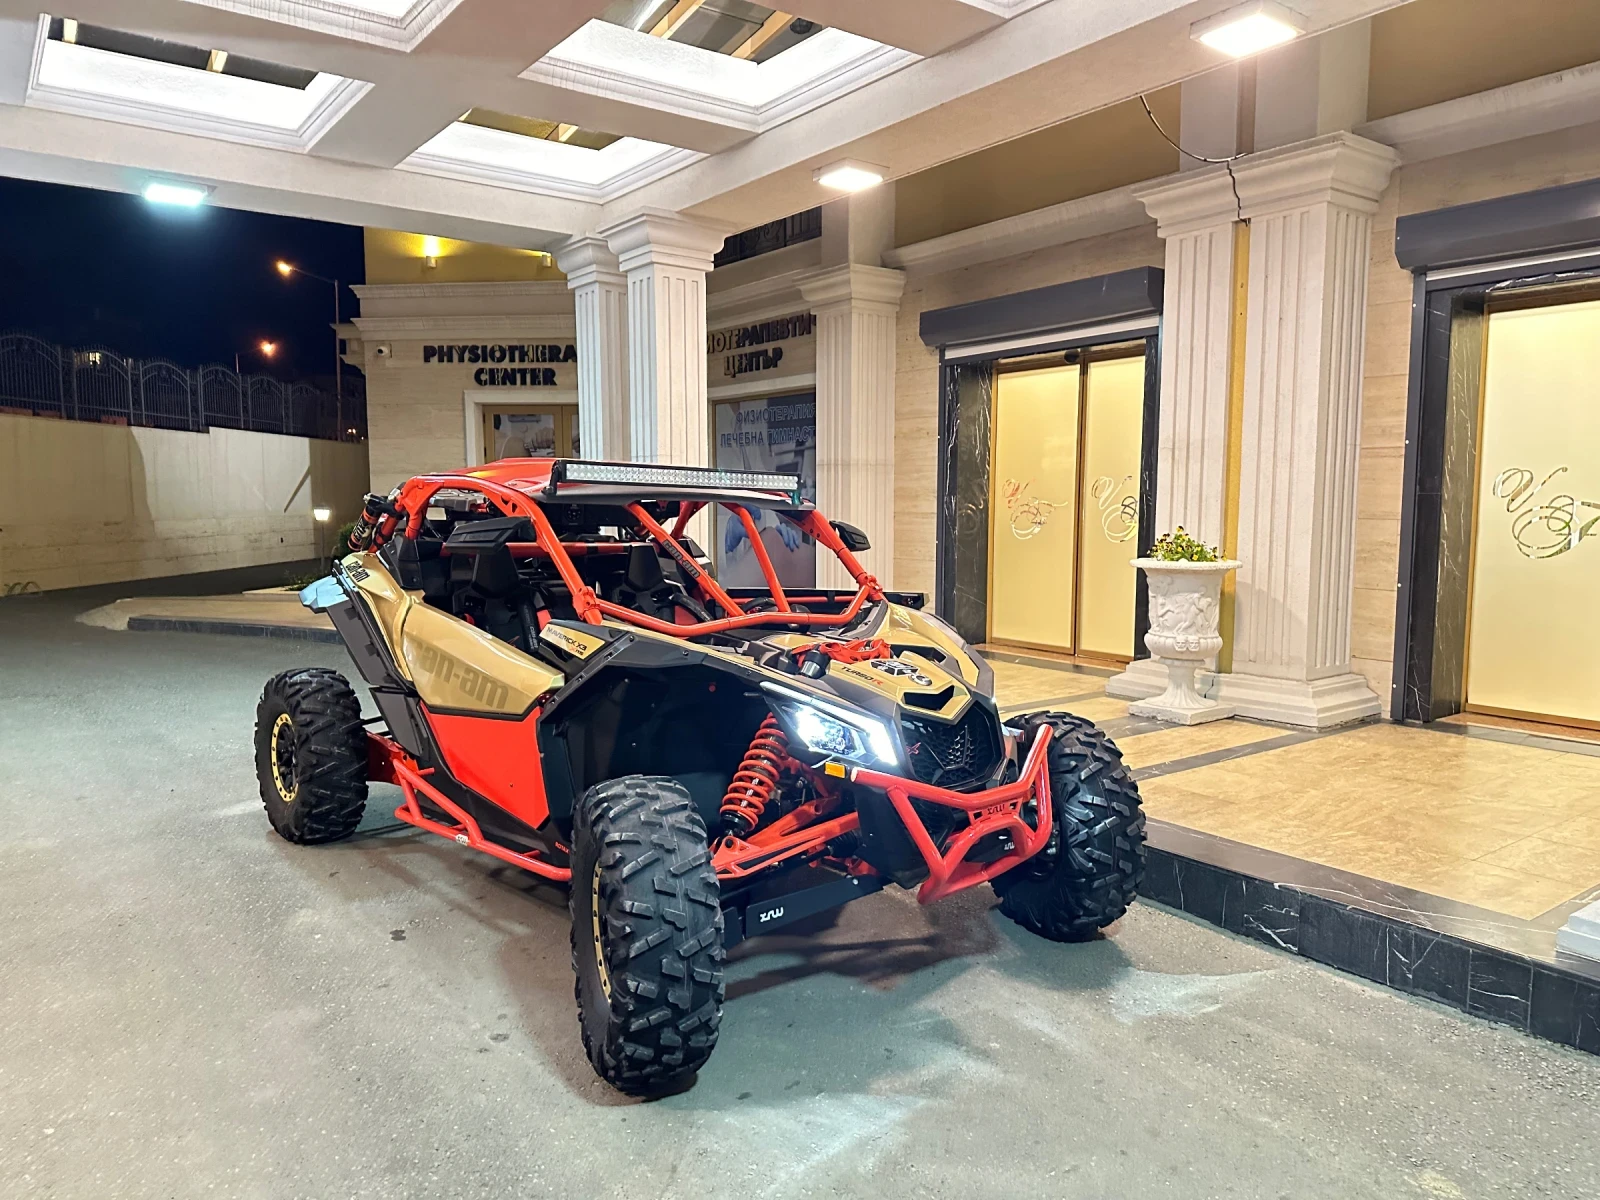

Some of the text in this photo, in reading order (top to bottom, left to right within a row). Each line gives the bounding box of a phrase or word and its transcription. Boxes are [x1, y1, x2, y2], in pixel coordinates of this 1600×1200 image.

[423, 344, 577, 363] PHYSIOTHERA
[724, 347, 783, 378] ЦЕНТЪР
[474, 368, 557, 386] CENTER
[720, 431, 764, 449] ЛЕЧЕБНА
[546, 626, 577, 646] MAVERICK
